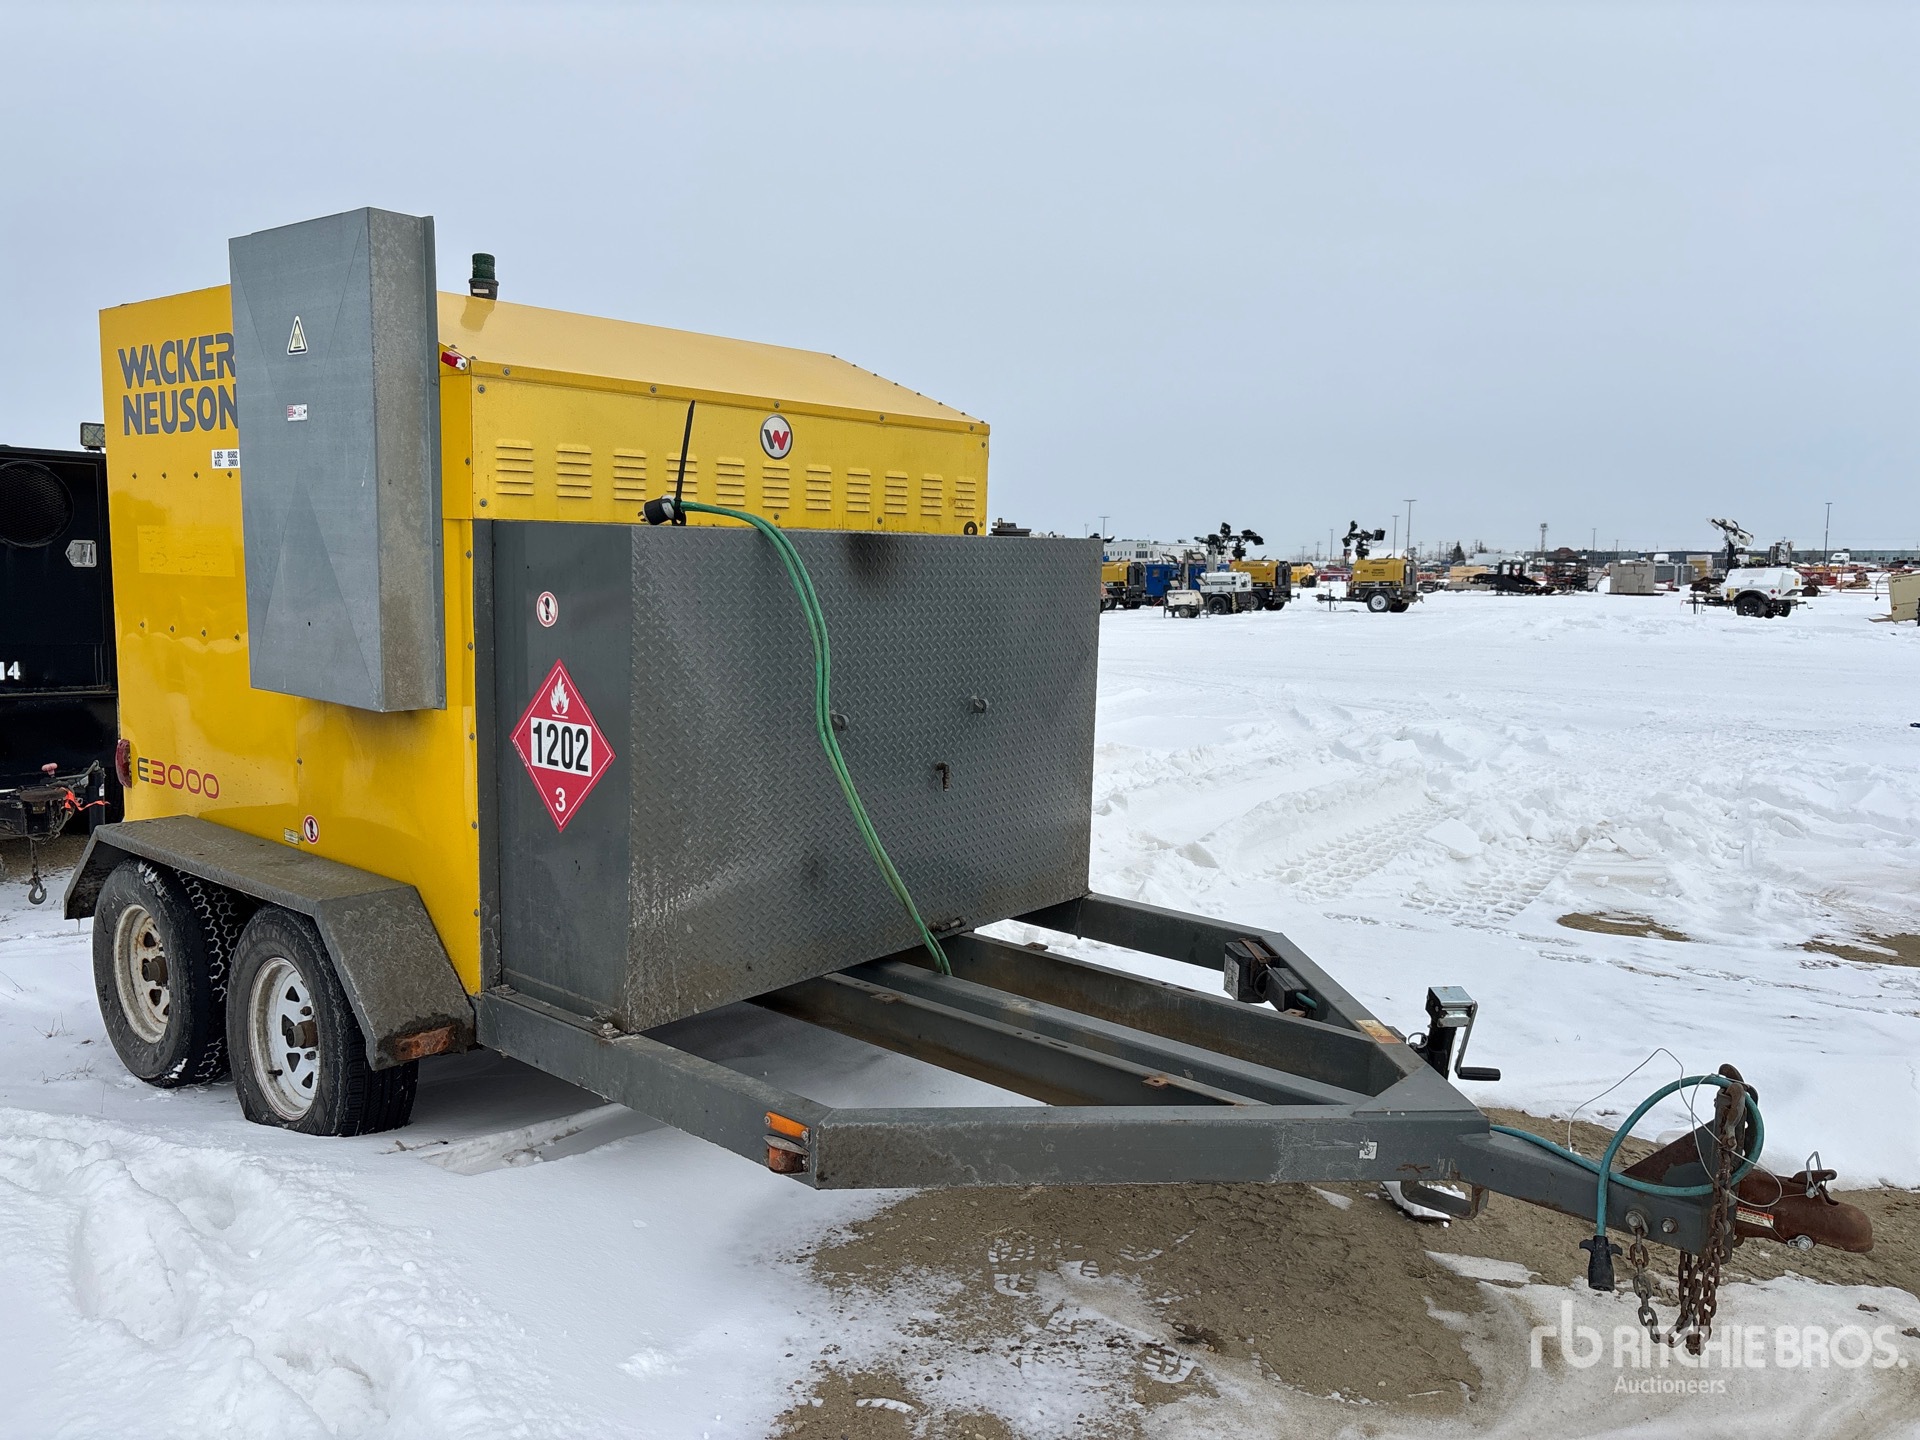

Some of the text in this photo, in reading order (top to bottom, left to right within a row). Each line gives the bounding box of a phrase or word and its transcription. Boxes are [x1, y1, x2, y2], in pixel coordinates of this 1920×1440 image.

[117, 332, 236, 390] WACKER
[122, 383, 239, 436] NEUSON
[213, 451, 224, 459] LBS
[214, 459, 239, 467] KG 3900
[532, 721, 589, 773] 1202
[137, 756, 220, 800] E3000
[555, 786, 566, 812] 3
